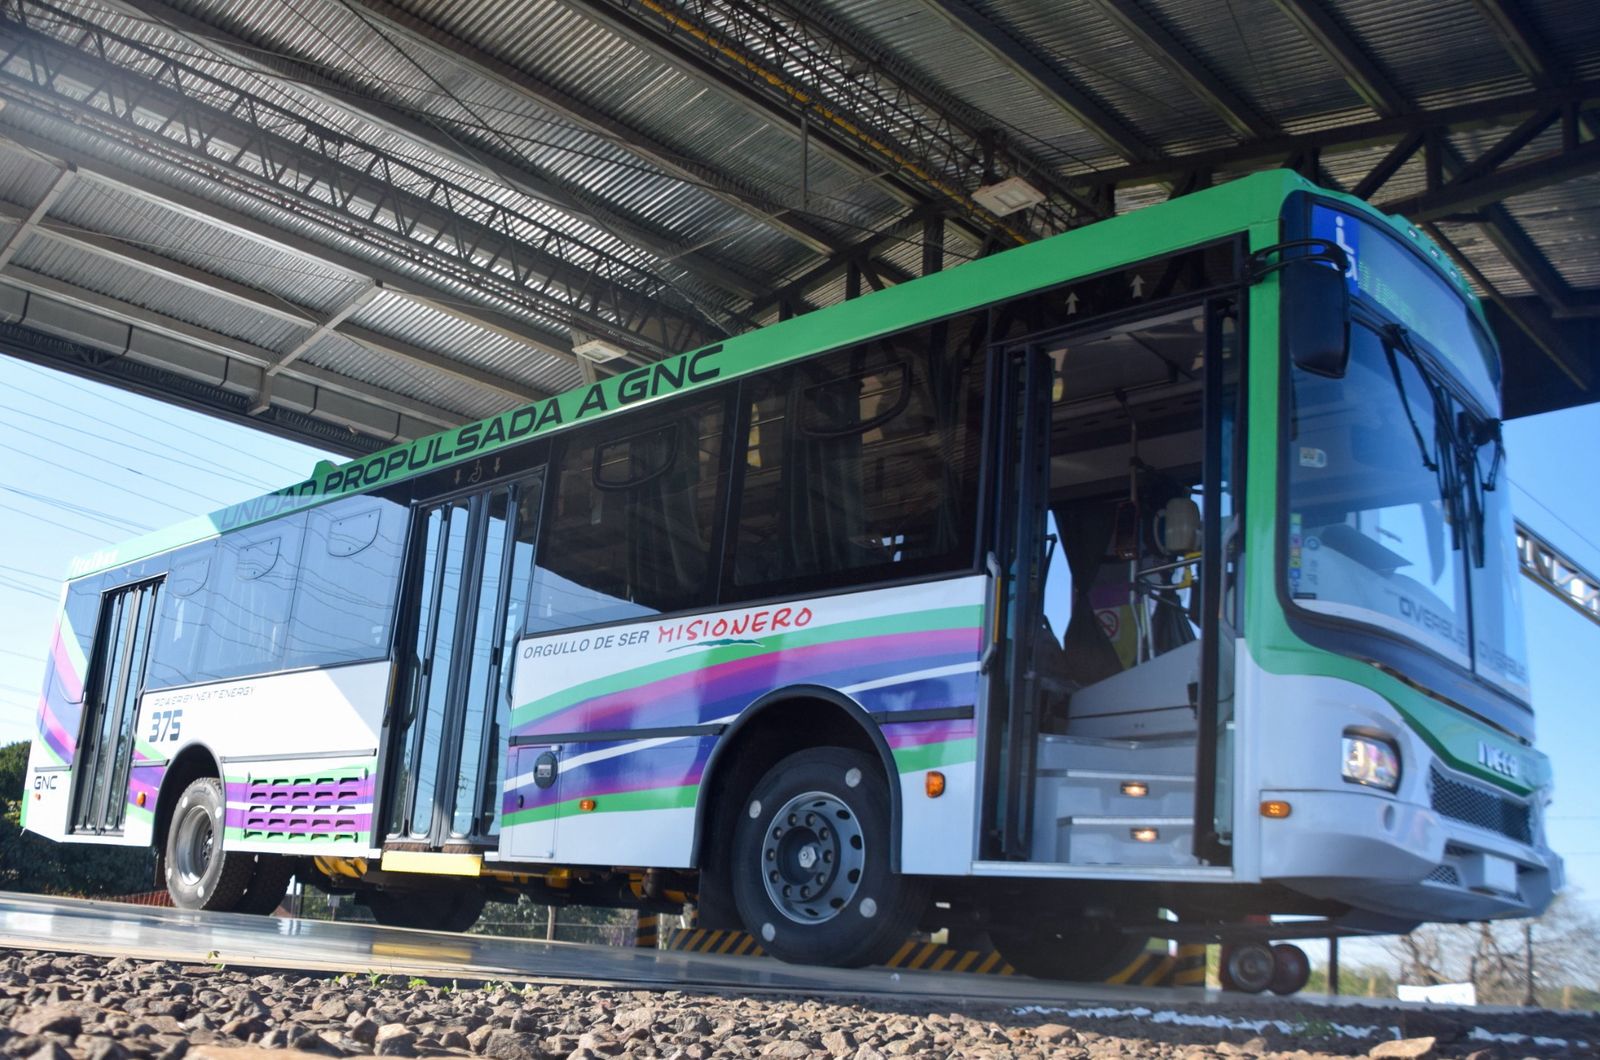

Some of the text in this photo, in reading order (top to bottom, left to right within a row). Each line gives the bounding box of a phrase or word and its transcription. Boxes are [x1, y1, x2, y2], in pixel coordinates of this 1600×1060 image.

[221, 344, 724, 528] UNIDAD PROPULSADA A GNC
[523, 607, 813, 659] ORGULLO DE SER MISIONERO
[149, 709, 183, 742] 375
[34, 776, 57, 790] GNC
